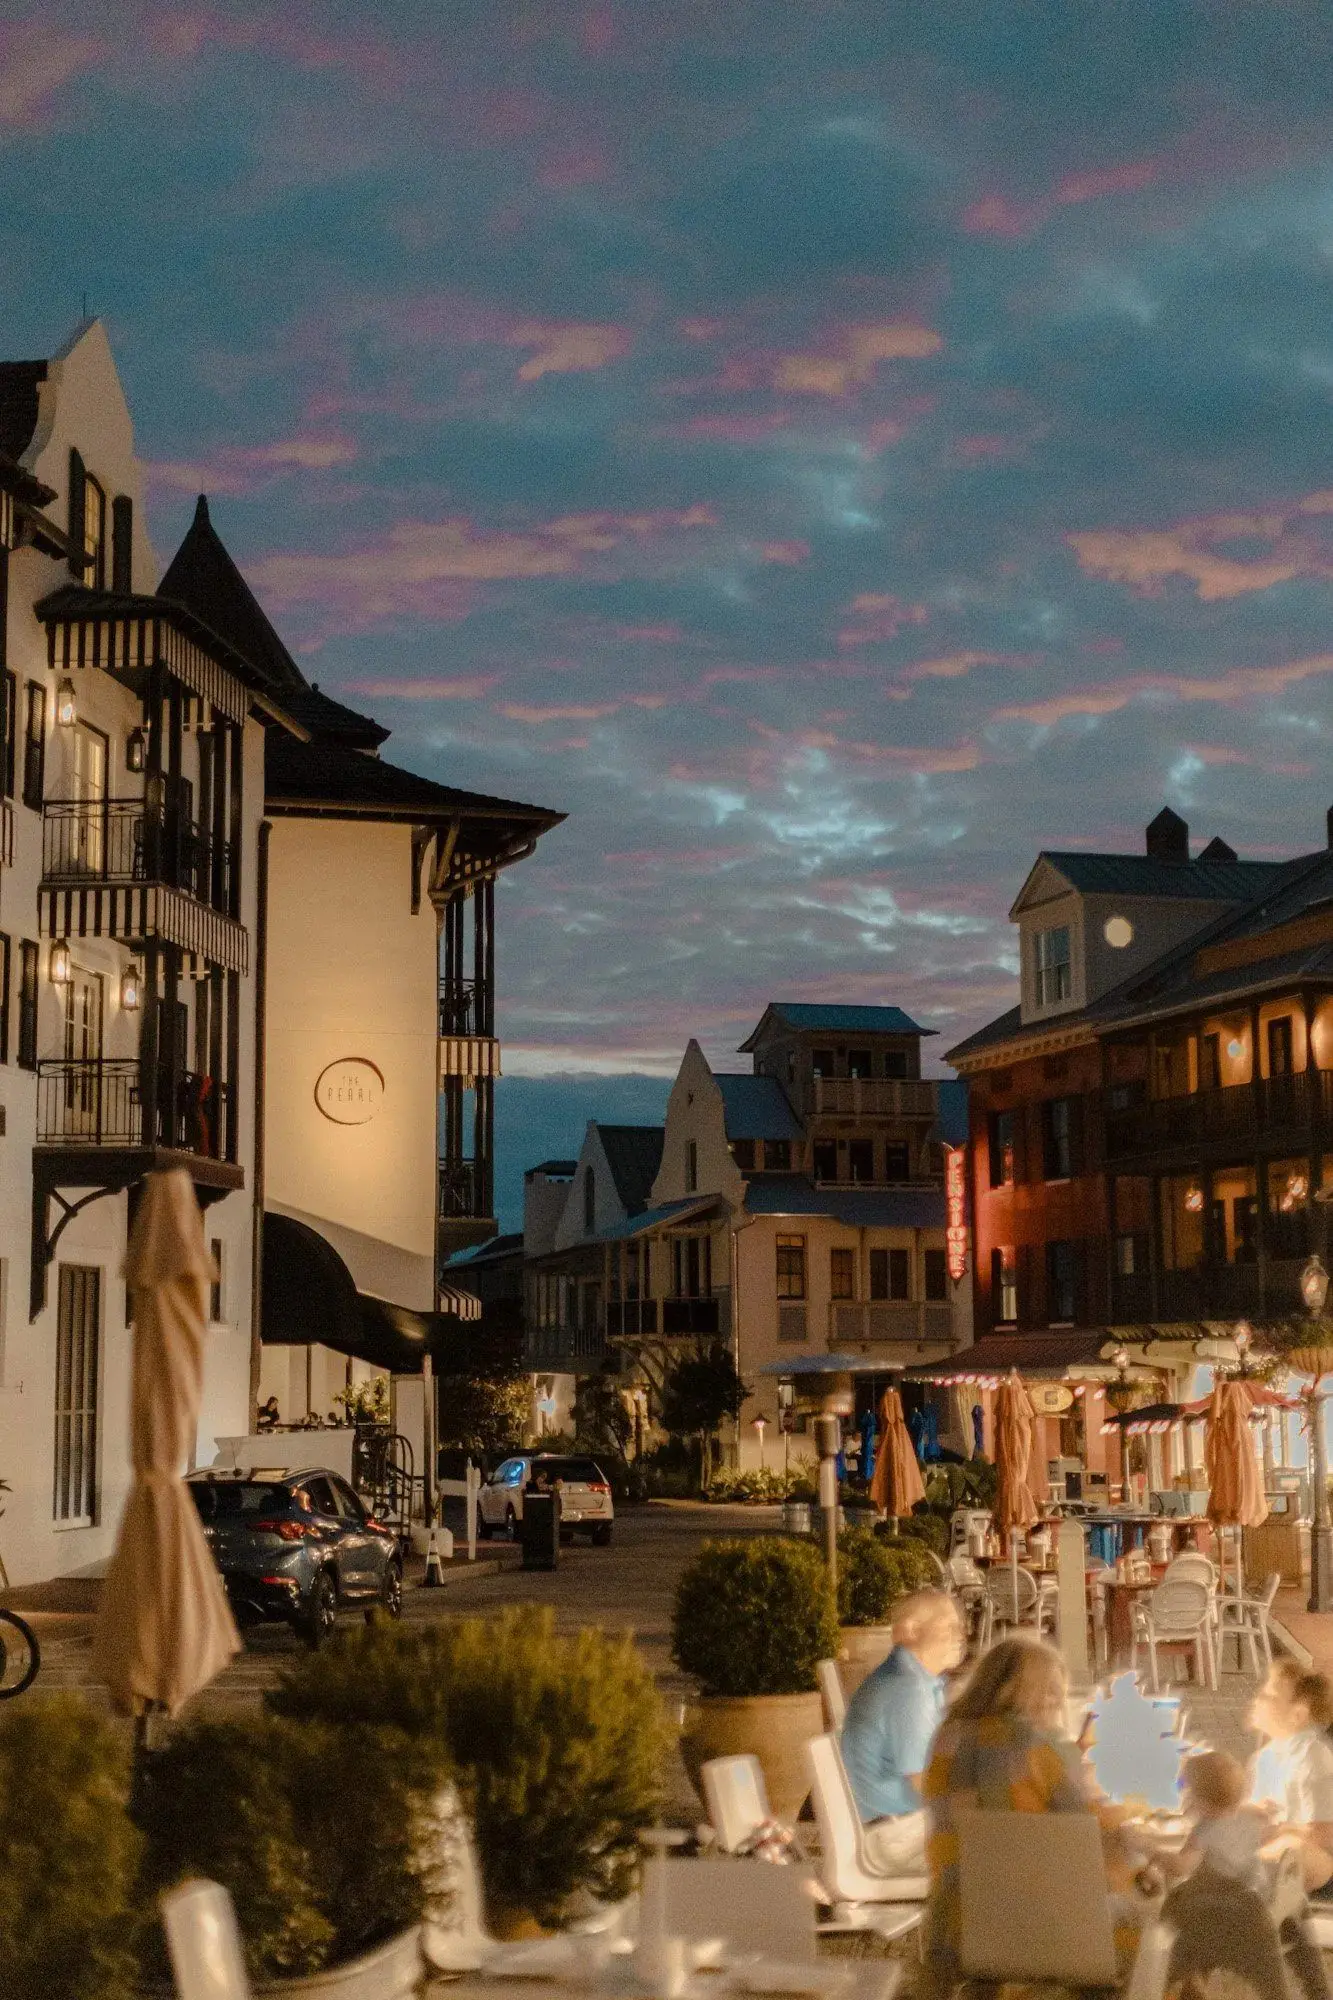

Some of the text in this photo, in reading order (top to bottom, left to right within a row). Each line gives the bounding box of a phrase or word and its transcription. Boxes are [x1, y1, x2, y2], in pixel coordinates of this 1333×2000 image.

[342, 1075, 359, 1087] THE
[328, 1088, 374, 1103] PEARL
[947, 1151, 966, 1271] PENSIONE
